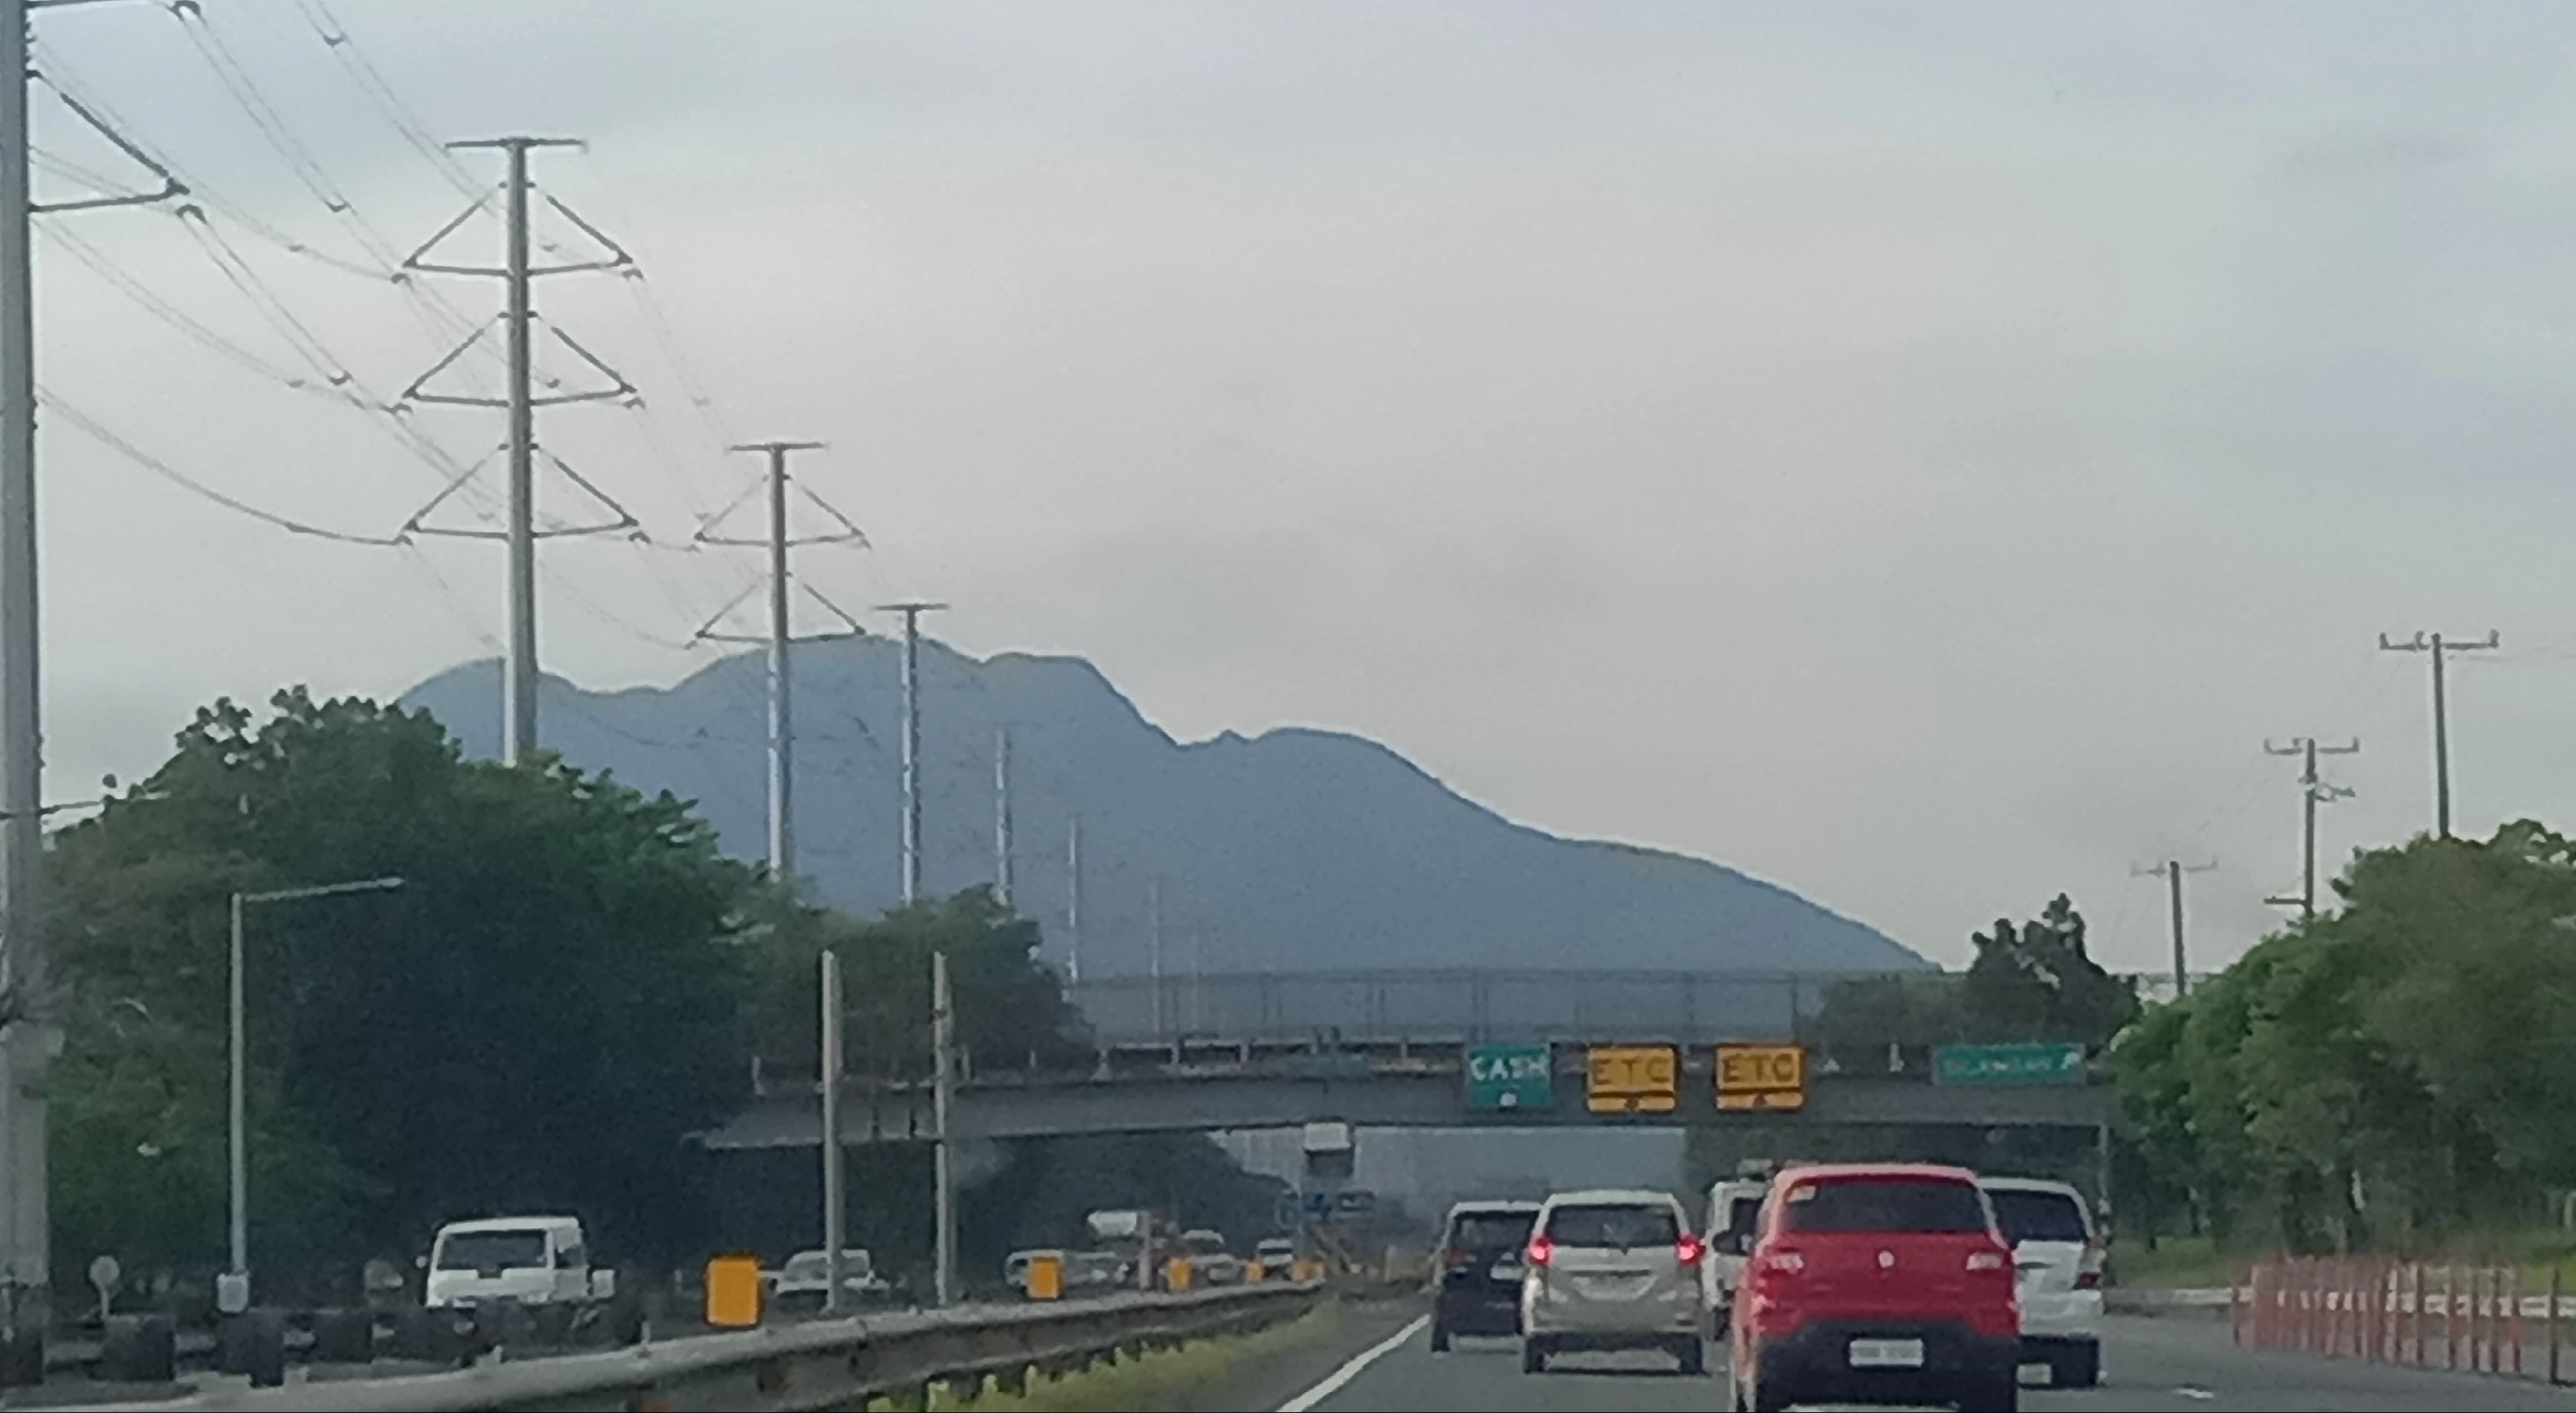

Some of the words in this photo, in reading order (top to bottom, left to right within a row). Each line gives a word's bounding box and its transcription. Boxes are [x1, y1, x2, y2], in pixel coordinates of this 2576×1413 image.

[1470, 1056, 1547, 1081] CASH
[1591, 1054, 1670, 1085] ETC
[1722, 1049, 1794, 1084] ETC
